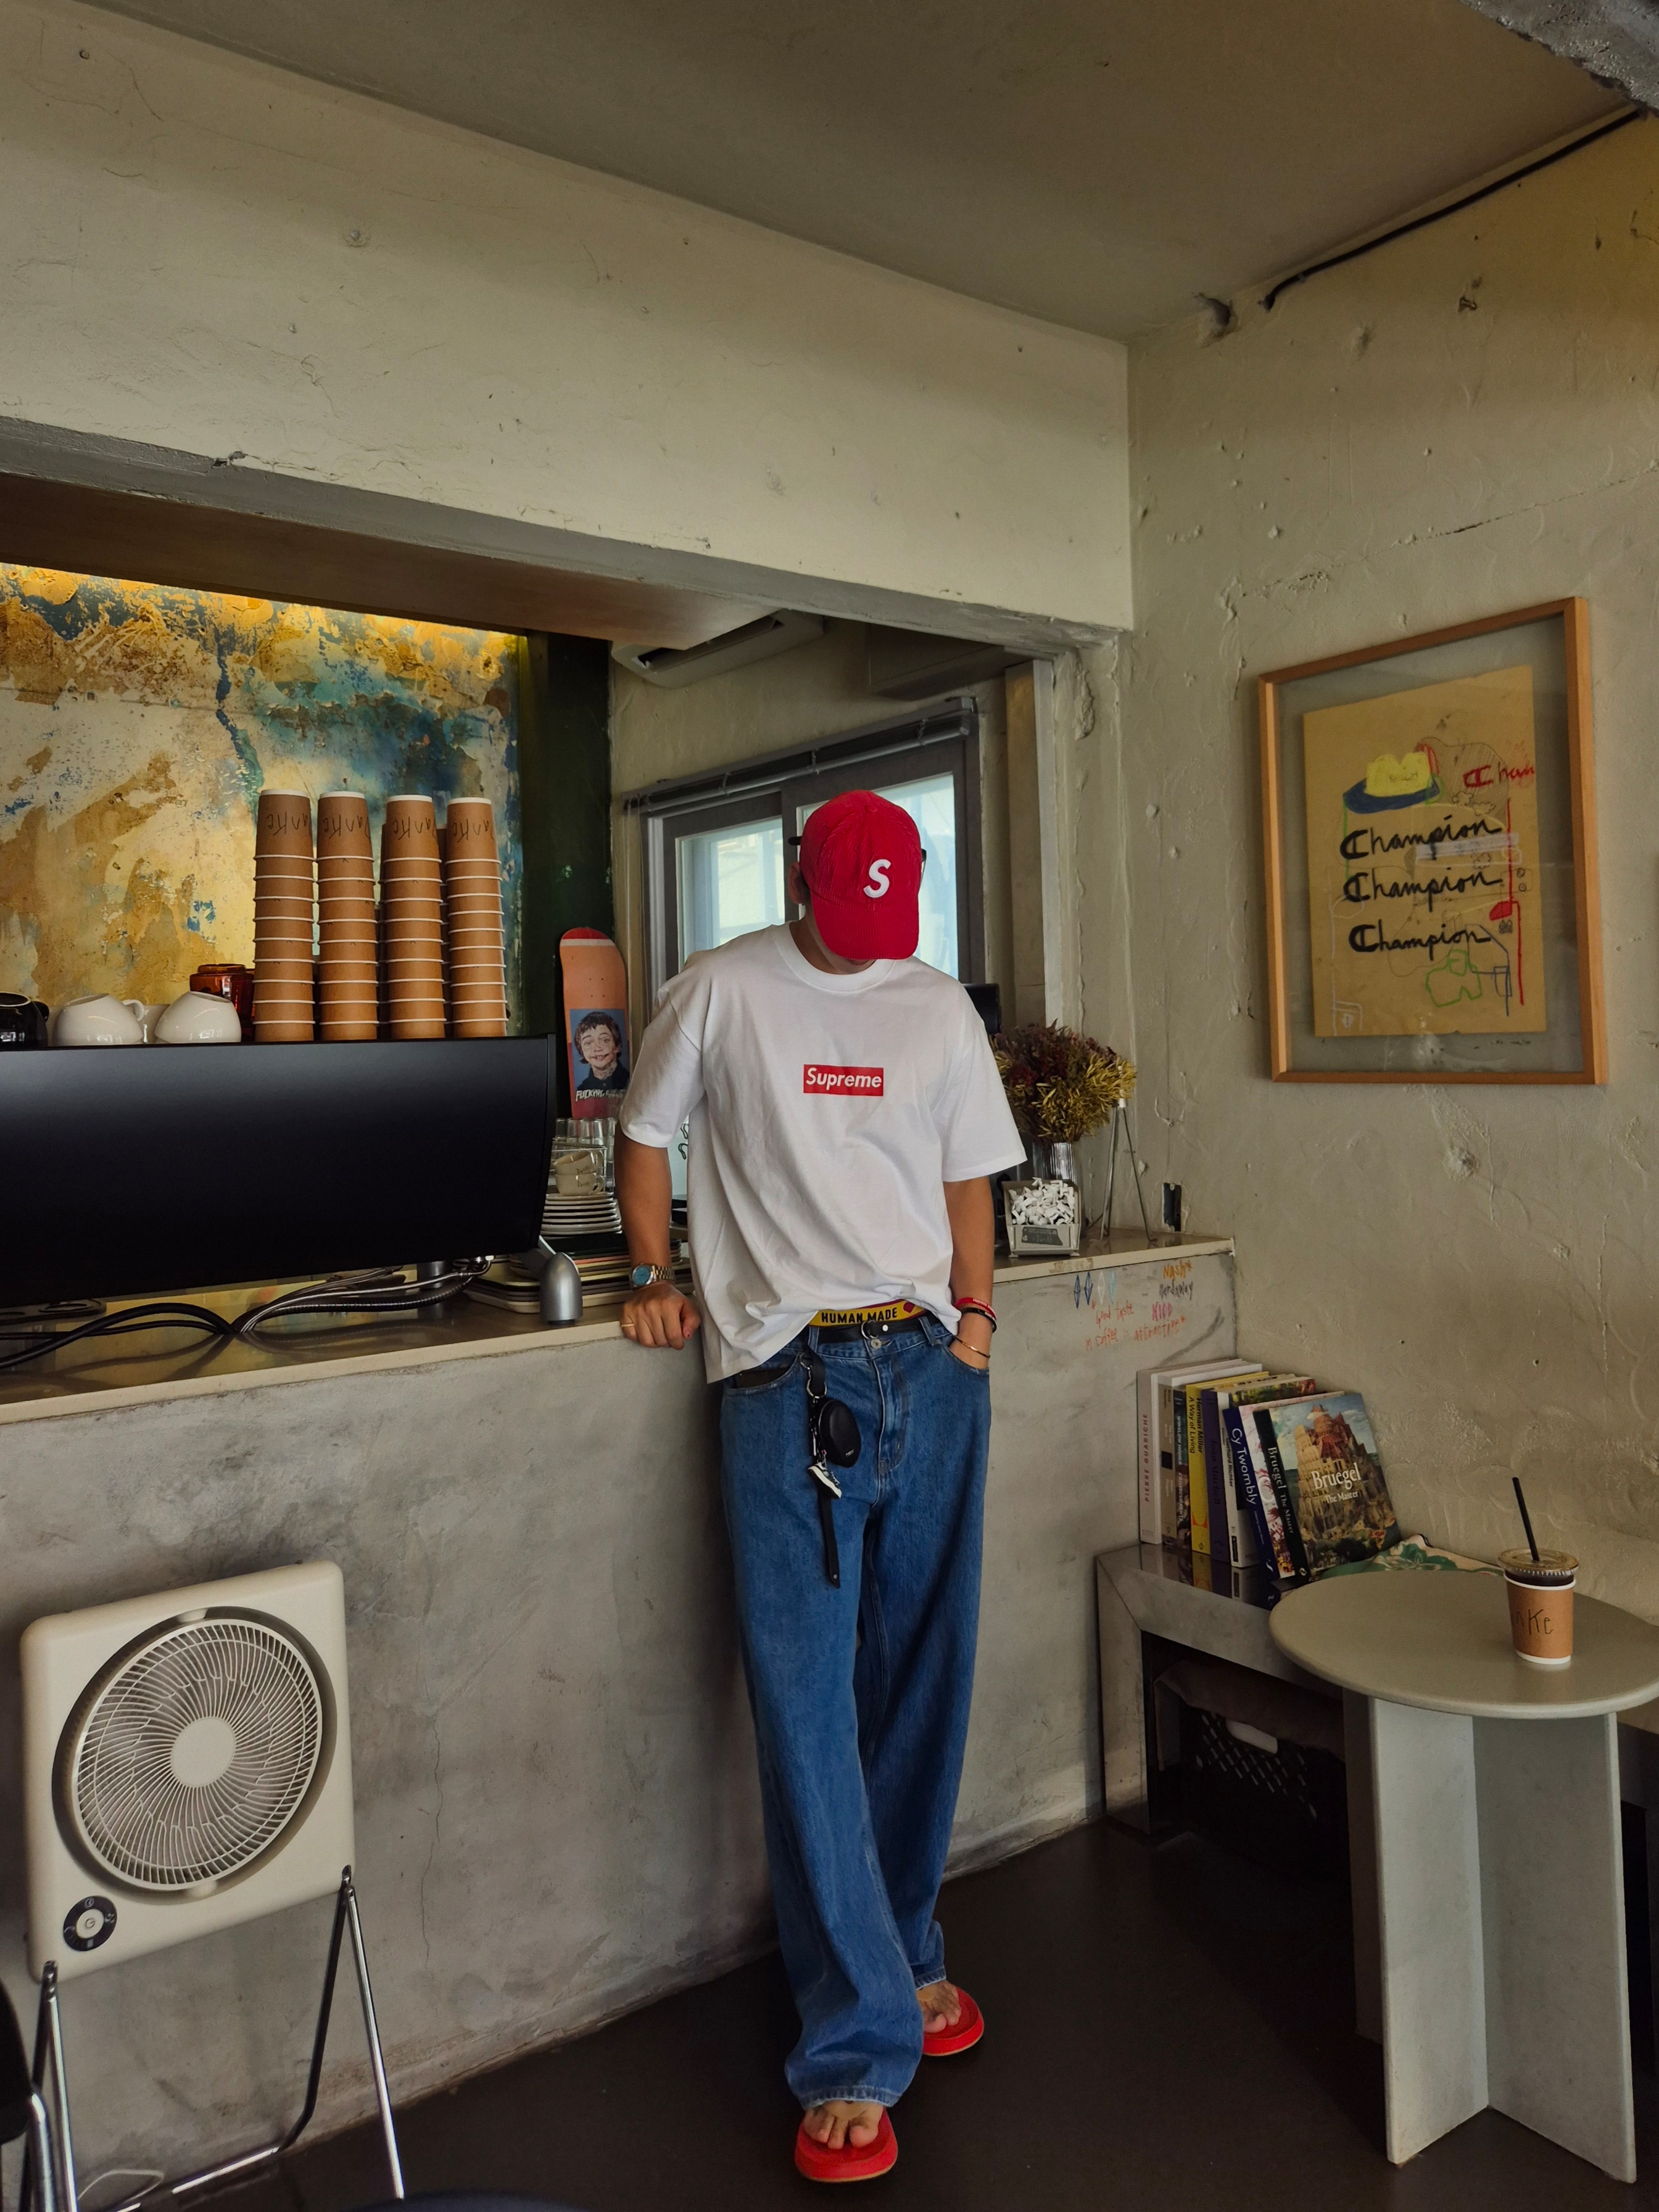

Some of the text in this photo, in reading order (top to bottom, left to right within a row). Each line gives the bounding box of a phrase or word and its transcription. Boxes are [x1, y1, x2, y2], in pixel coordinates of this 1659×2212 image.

[1339, 814, 1502, 860] Champion
[863, 859, 892, 898] S
[1343, 867, 1503, 913] Champion
[1348, 918, 1492, 962] Champion
[805, 1067, 882, 1091] Supreme
[821, 1307, 898, 1324] HUMAN MADE
[1191, 1421, 1196, 1430] of
[1230, 1428, 1258, 1505] Cy Twombly
[1311, 1461, 1362, 1490] Bruegel
[1268, 1446, 1287, 1490] Bruegel
[1284, 1509, 1294, 1534] Master
[1325, 1490, 1359, 1504] The Master
